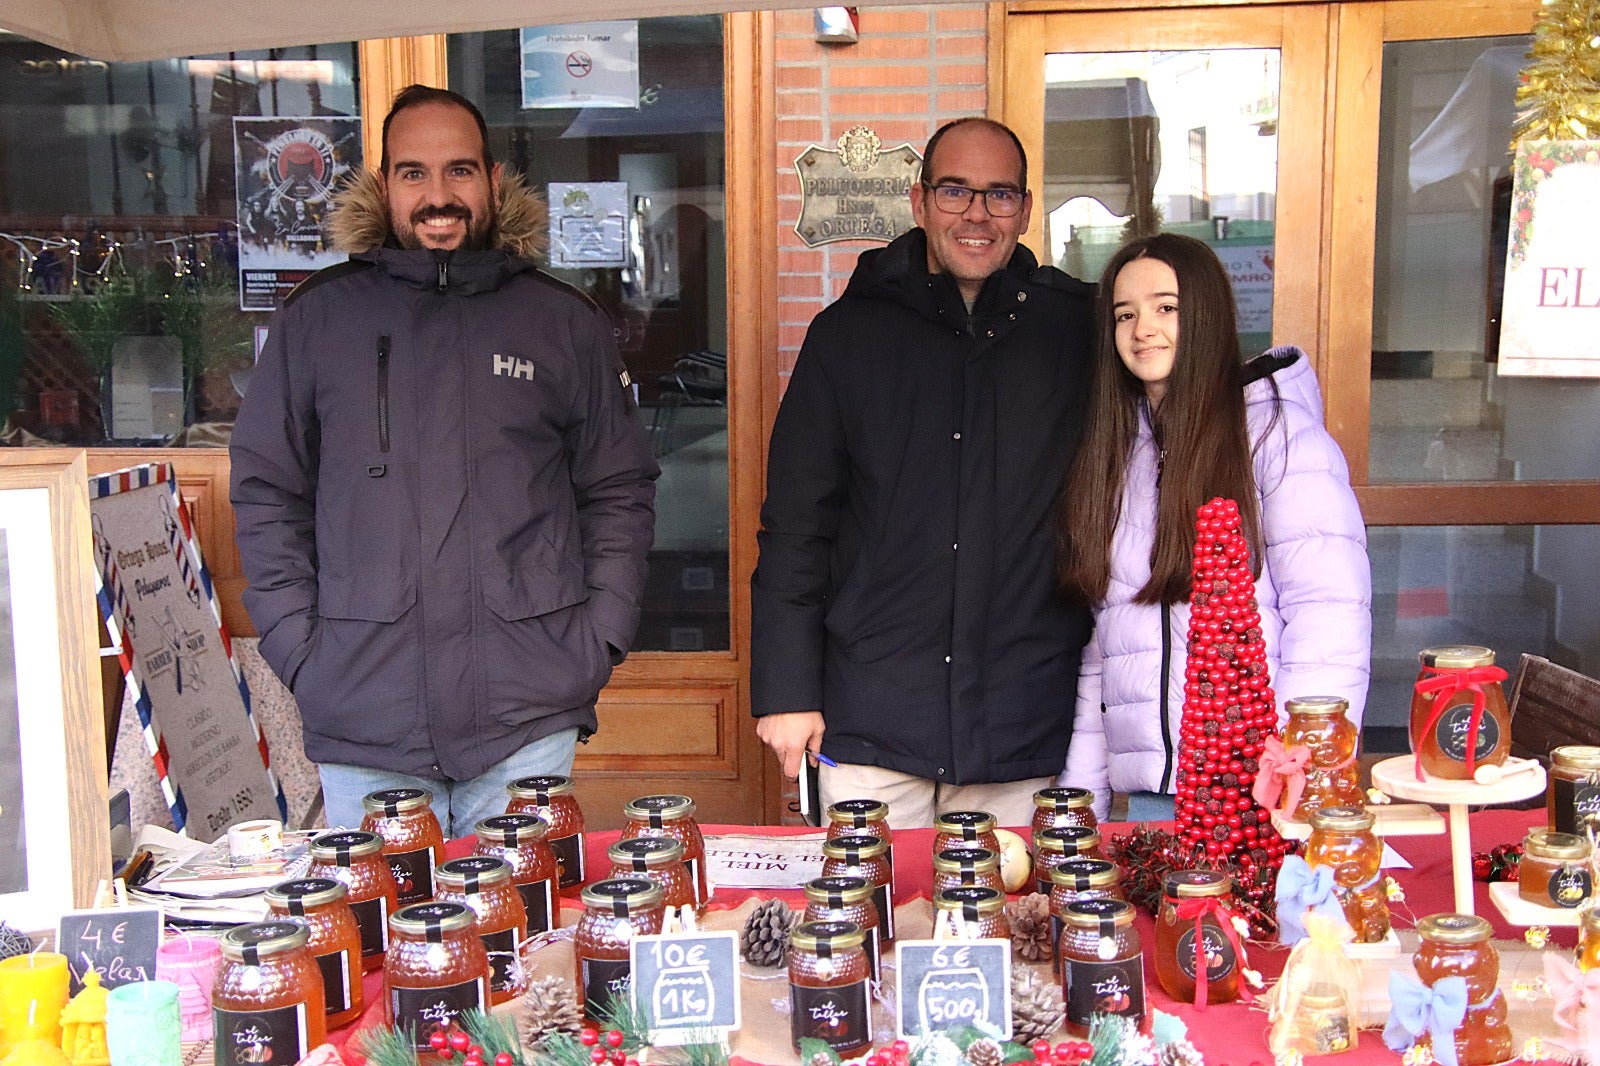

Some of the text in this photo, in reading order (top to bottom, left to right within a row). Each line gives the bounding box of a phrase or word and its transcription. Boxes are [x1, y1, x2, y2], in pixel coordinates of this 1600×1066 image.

[546, 34, 611, 42] Prohibido fumar
[806, 177, 912, 197] PELUQUERIA
[821, 217, 897, 237] ORTEGA
[245, 272, 277, 281] VIERNES
[1536, 266, 1600, 308] EL
[493, 353, 535, 381] HH
[145, 634, 206, 675] BARBER SHOP
[721, 860, 790, 871] MIEL
